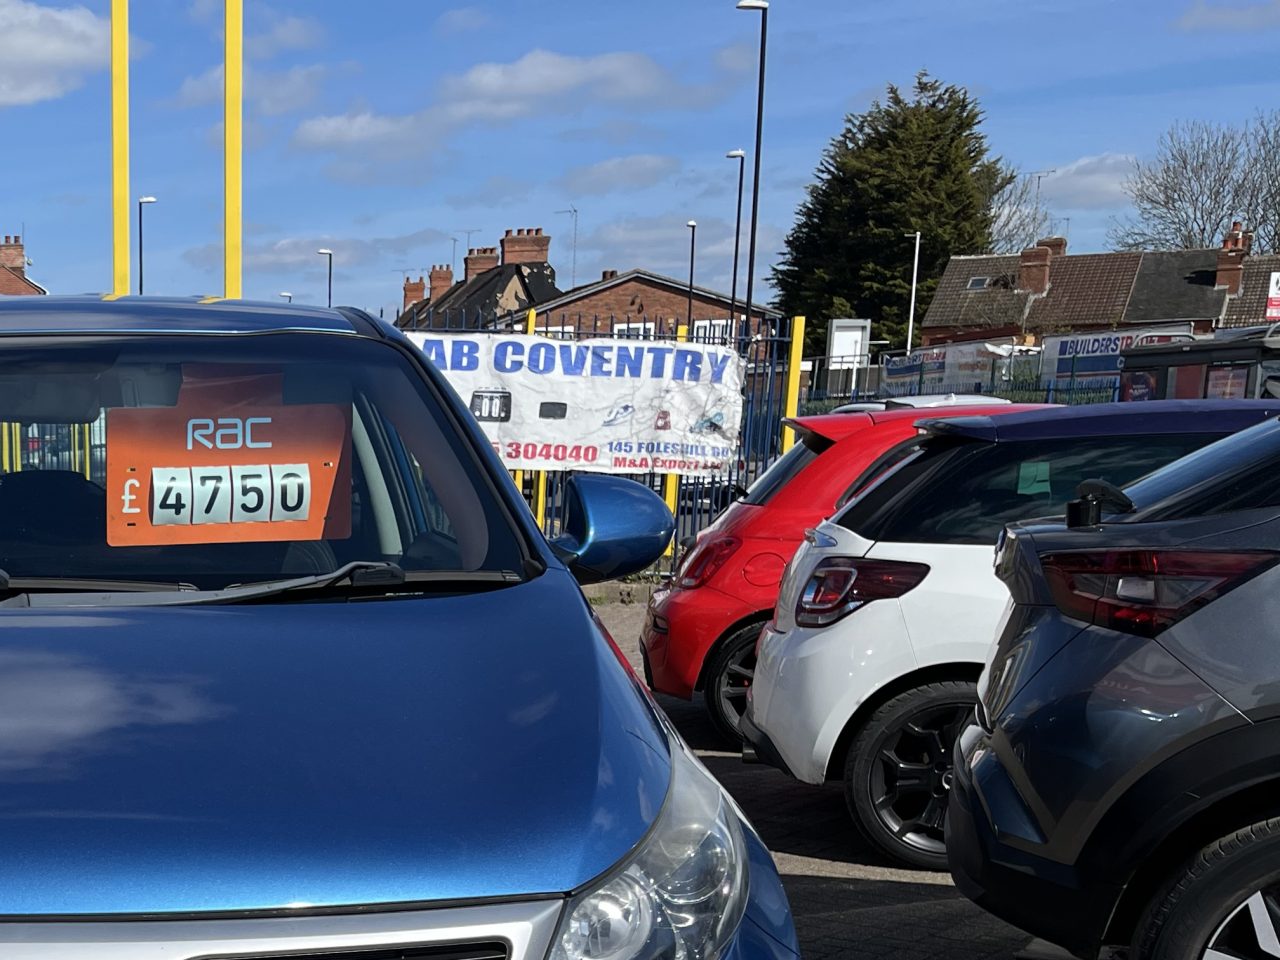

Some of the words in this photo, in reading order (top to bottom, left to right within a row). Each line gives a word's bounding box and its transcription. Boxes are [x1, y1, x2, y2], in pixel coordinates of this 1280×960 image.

[493, 340, 731, 384] COVENTRY
[506, 442, 599, 463] 304040
[608, 441, 633, 453] 145
[613, 456, 649, 468] M&A
[158, 472, 305, 516] 4750
